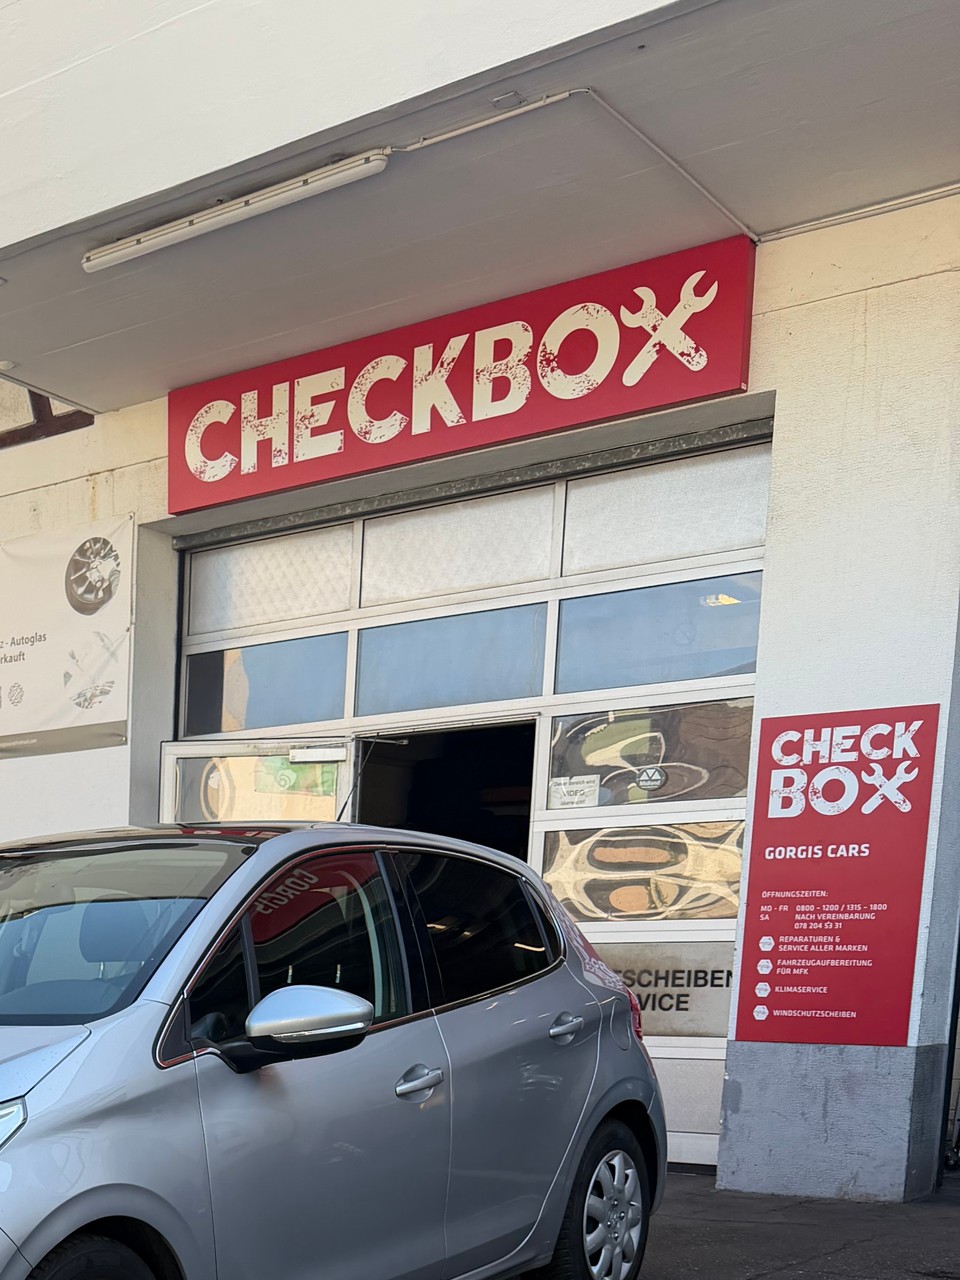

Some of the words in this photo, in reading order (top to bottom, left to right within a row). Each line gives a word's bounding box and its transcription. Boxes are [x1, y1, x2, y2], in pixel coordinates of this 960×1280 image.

[184, 269, 719, 483] CHECKBOX
[10, 632, 47, 646] Autoglas
[771, 720, 924, 766] CHECK
[768, 760, 919, 819] BOX
[765, 845, 823, 859] GORGIS
[827, 843, 870, 858] CARS
[761, 890, 829, 898] ÖFFNUNGSZEITEN:
[772, 1009, 857, 1018] WINDSCHUTZSCHEIBEN
